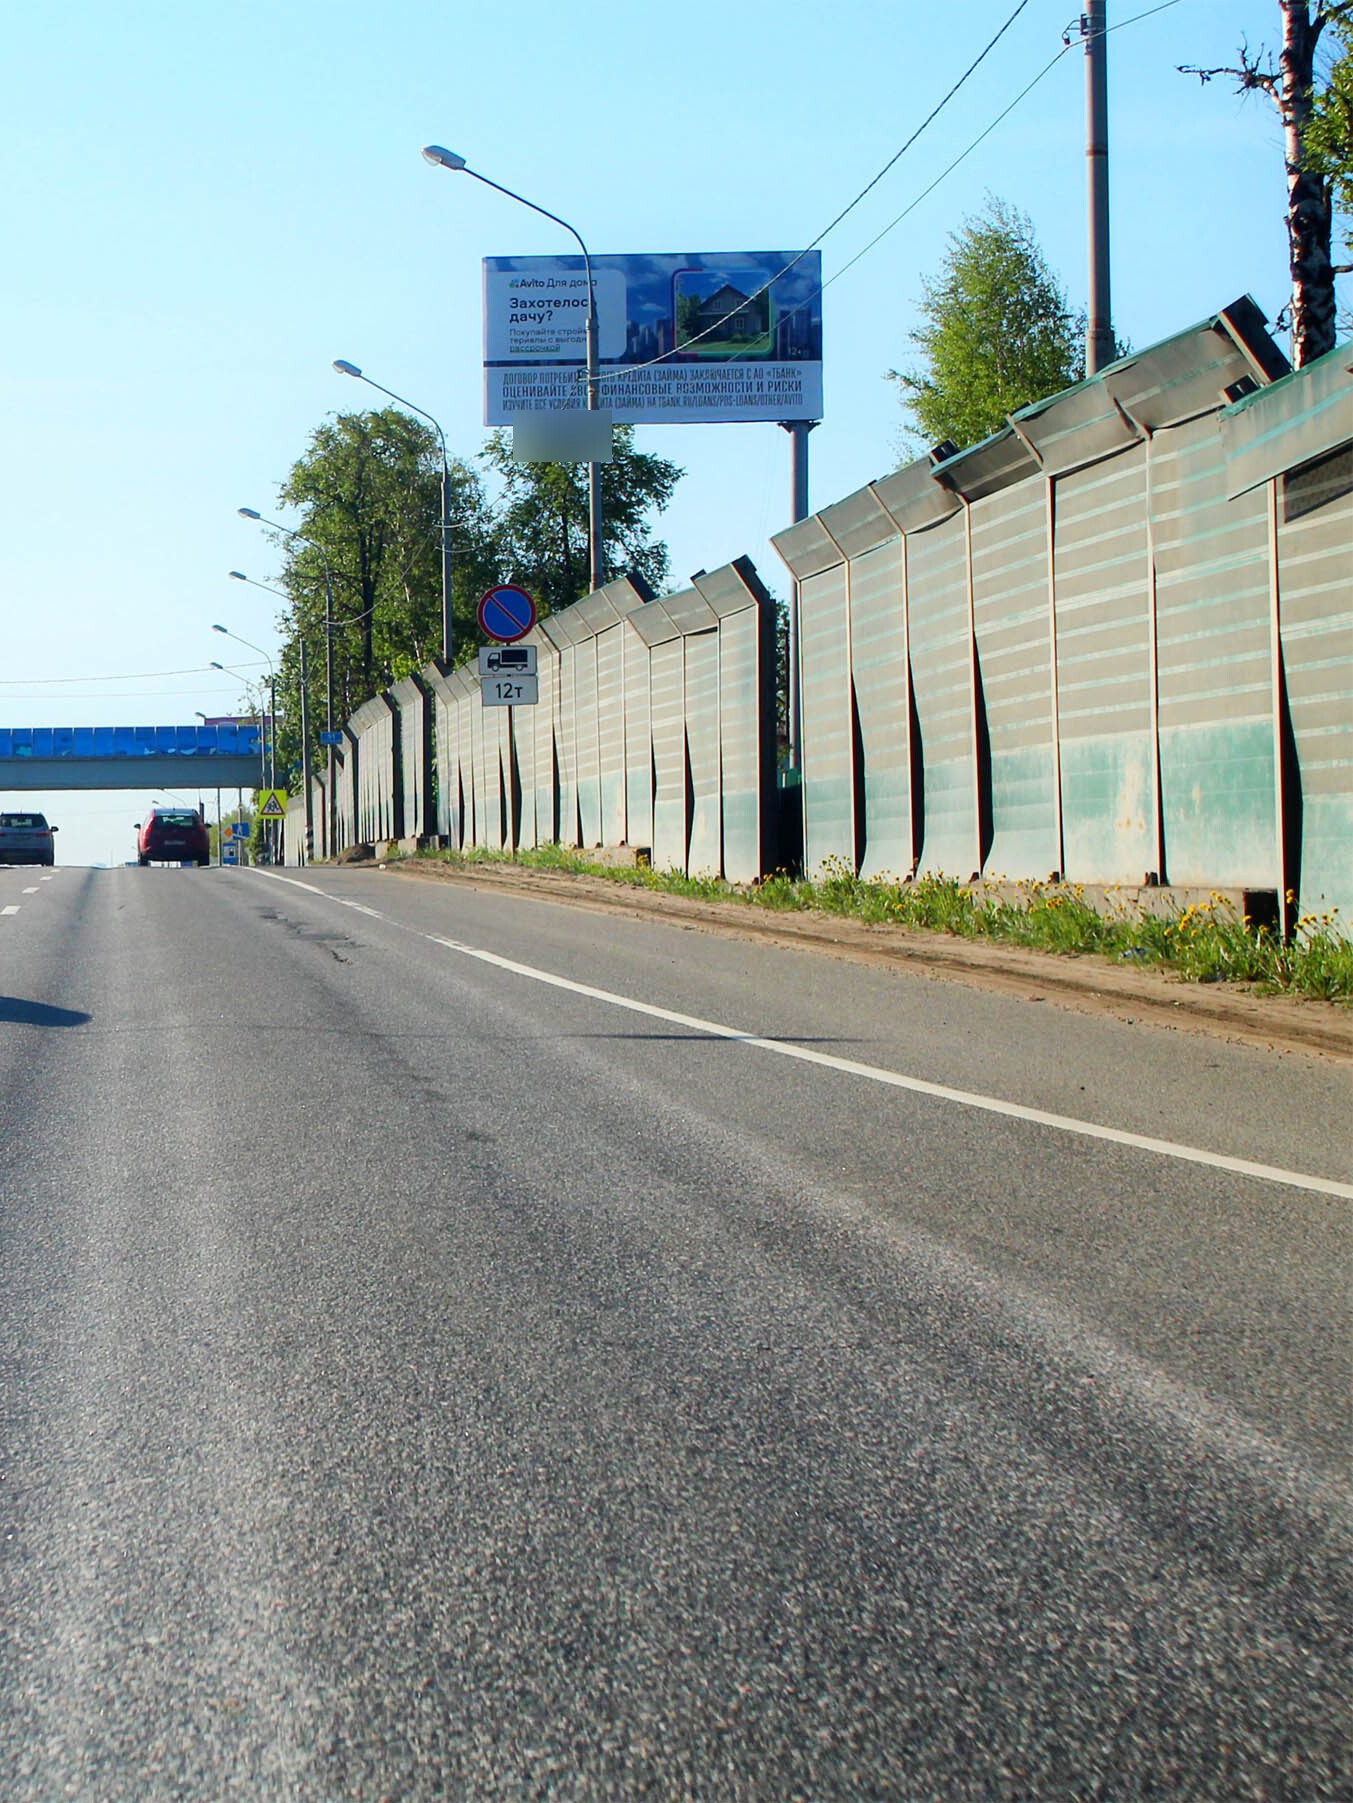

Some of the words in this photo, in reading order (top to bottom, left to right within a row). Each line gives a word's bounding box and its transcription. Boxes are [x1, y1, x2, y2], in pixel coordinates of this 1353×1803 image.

[519, 278, 545, 288] Avito
[546, 278, 567, 288] Для
[509, 297, 589, 309] Захотелос
[509, 310, 553, 324] дачу?
[509, 328, 555, 337] Покупайте
[509, 344, 560, 353] рассрочкой
[503, 372, 537, 386] ДОГОВОР
[654, 368, 688, 382] (ЗАЙМА)
[689, 368, 744, 381] ЗАКЛЮЧАЕТСЯ
[746, 368, 752, 380] С
[753, 367, 764, 380] АО
[766, 367, 802, 379] «ТБАНК»
[503, 384, 566, 399] ОЦЕНИВАЙТЕ
[570, 384, 589, 397] СВО
[601, 382, 673, 396] ФИНАНСОВЫЕ
[676, 381, 753, 395] ВОЗМОЖНОСТИ
[756, 381, 764, 393] И
[767, 379, 802, 393] РИСКИ
[534, 399, 546, 410] ВСЕ
[615, 397, 646, 409] (ЗАЙМА)
[647, 396, 657, 408] НА
